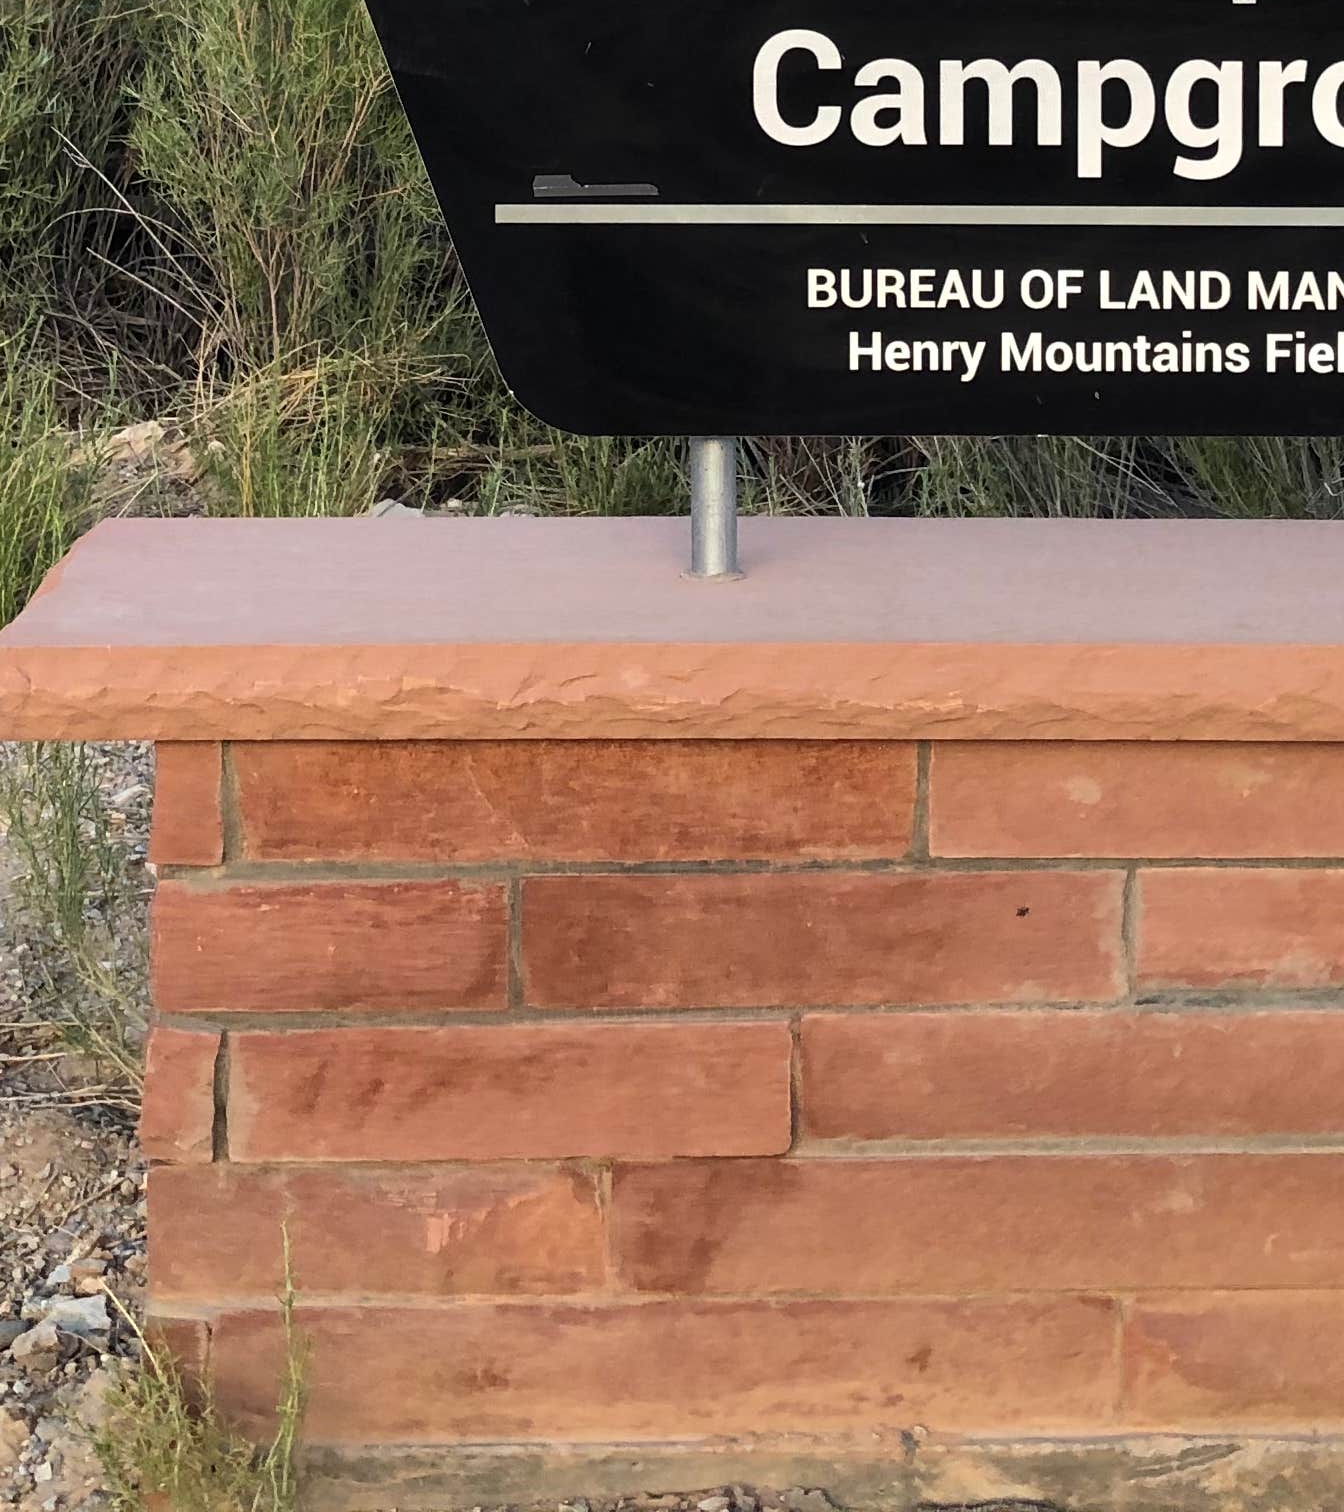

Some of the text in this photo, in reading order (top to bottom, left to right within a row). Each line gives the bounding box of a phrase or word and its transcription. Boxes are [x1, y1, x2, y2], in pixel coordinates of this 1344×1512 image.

[807, 268, 1004, 310] BUREAU
[1020, 268, 1085, 310] OF
[1099, 269, 1231, 310] LAND
[849, 331, 987, 382] Henry
[1001, 330, 1250, 374] Mountains
